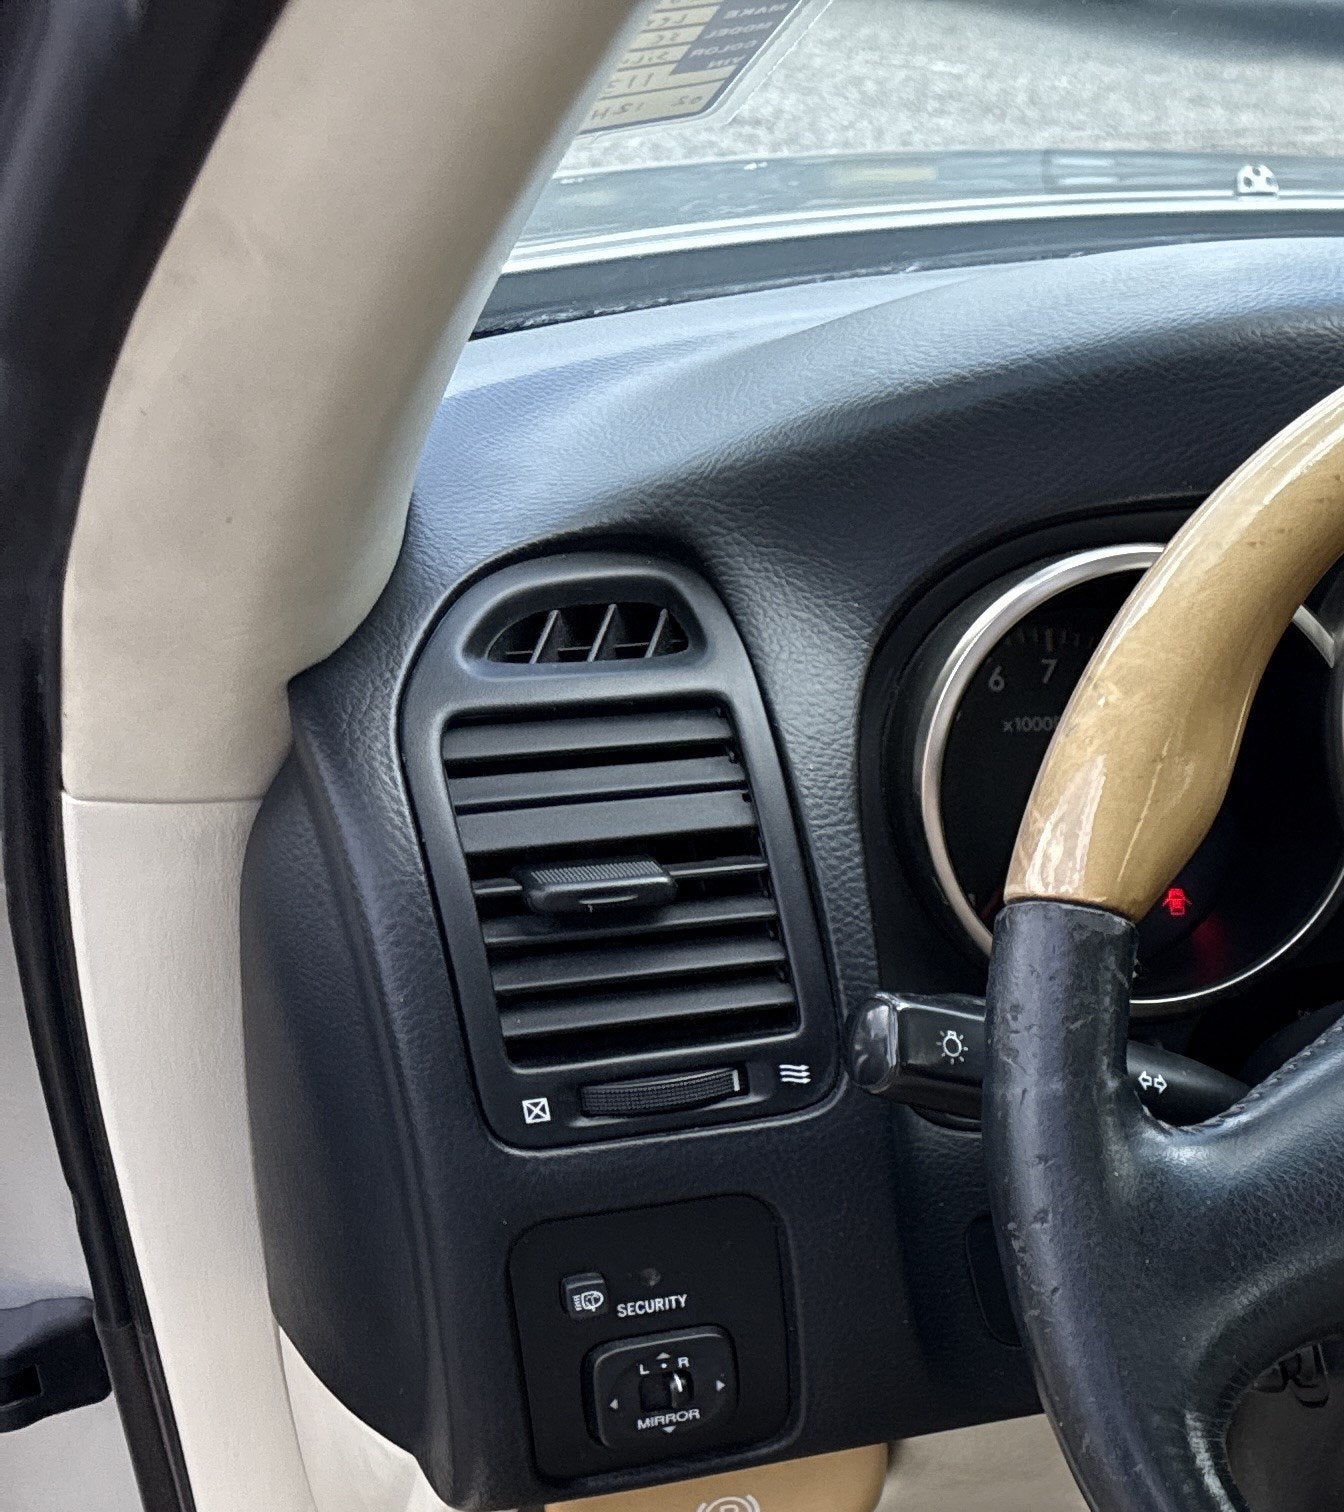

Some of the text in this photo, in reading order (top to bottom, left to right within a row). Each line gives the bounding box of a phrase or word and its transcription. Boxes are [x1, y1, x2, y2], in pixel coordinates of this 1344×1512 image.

[988, 666, 1005, 693] 6
[1041, 658, 1058, 684] 7
[1002, 715, 1059, 734] x1000
[617, 1294, 687, 1318] SECURITY
[639, 1363, 650, 1375] L
[678, 1356, 690, 1368] R
[637, 1408, 701, 1430] MIRROR
